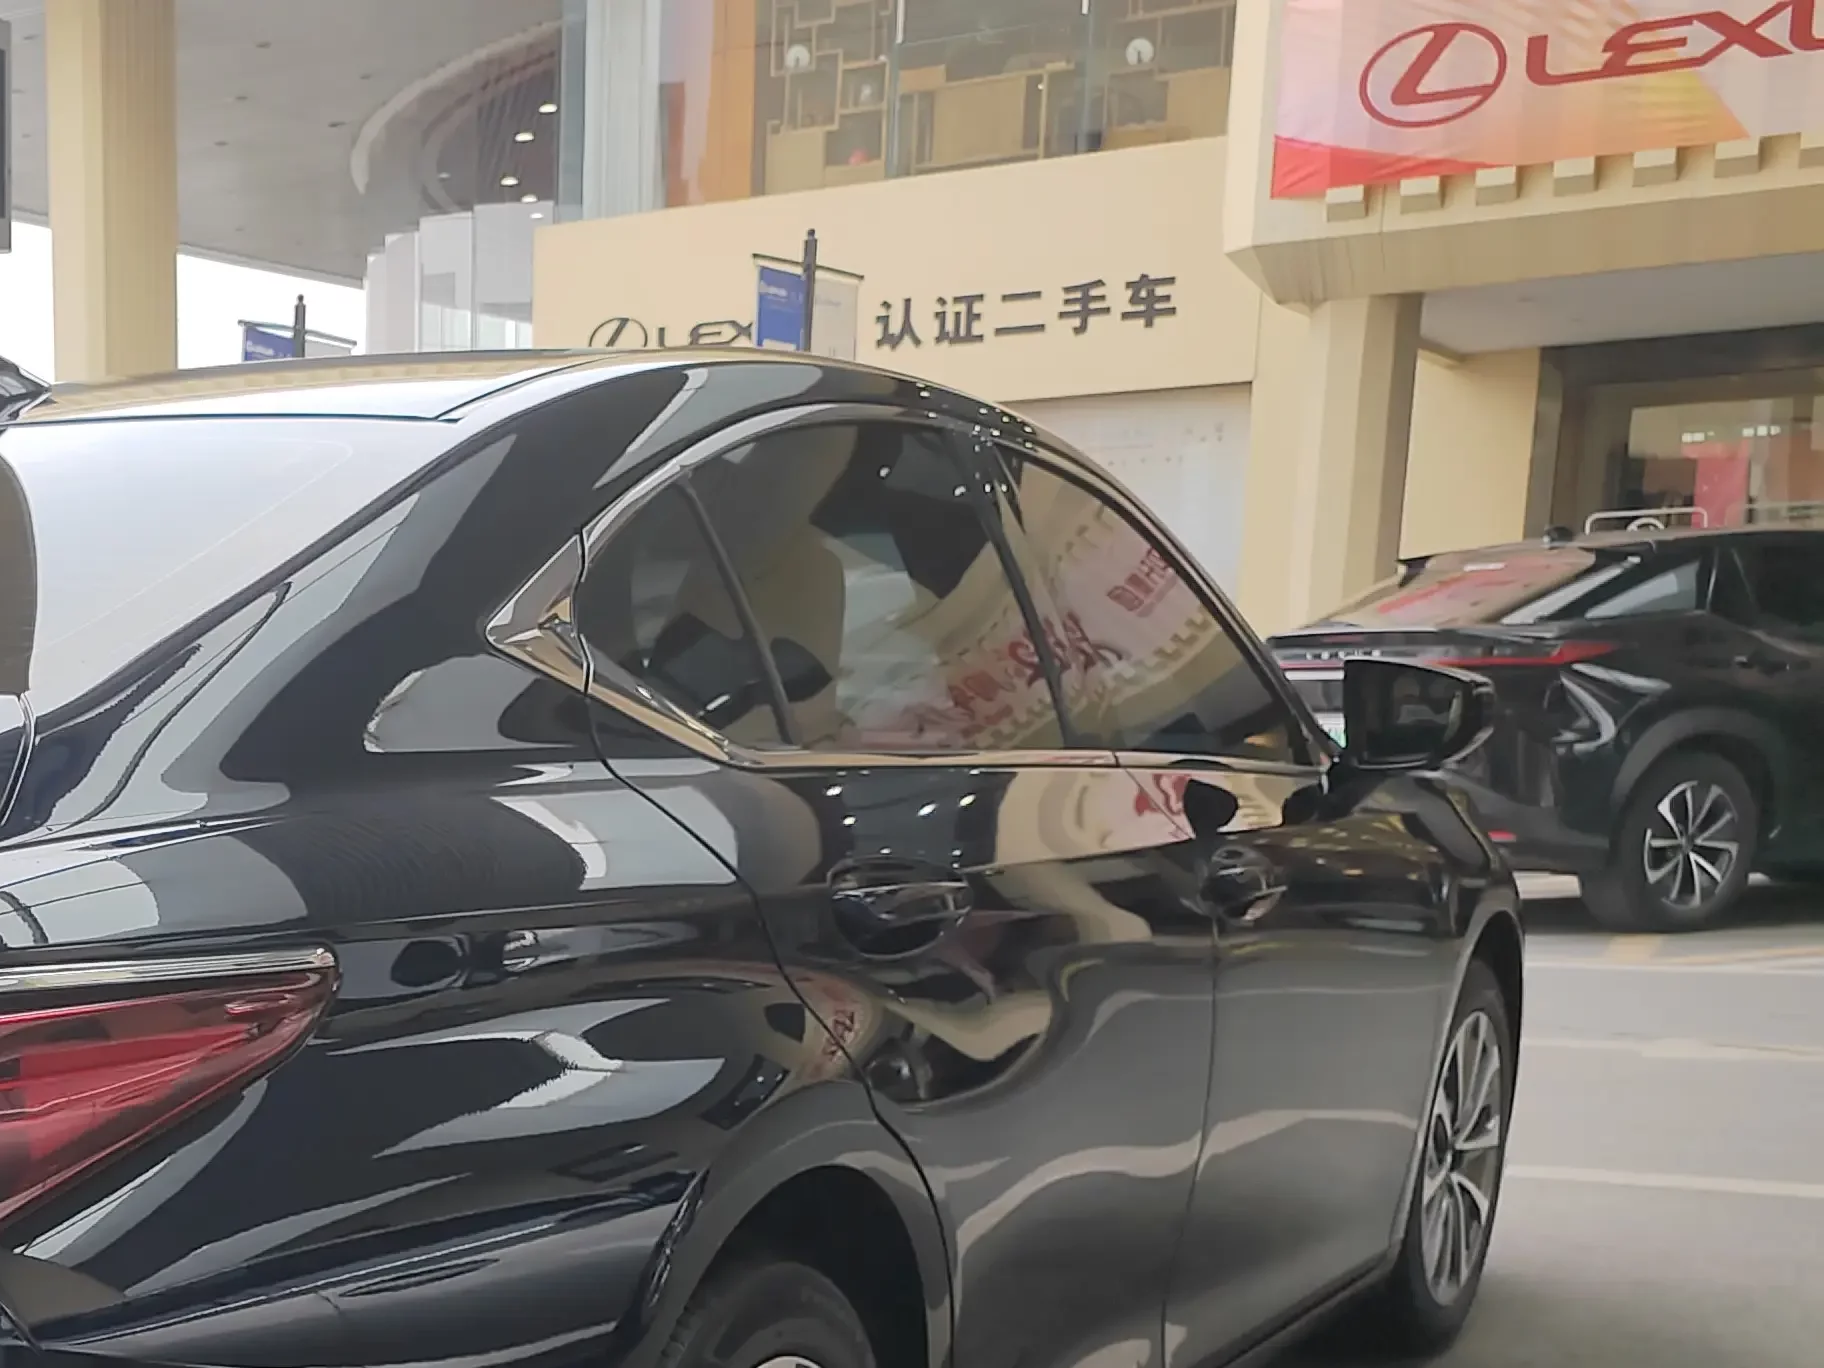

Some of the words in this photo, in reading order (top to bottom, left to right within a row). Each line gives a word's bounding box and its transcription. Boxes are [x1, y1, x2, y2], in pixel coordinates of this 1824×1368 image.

[875, 273, 1177, 351] 认证二手车
